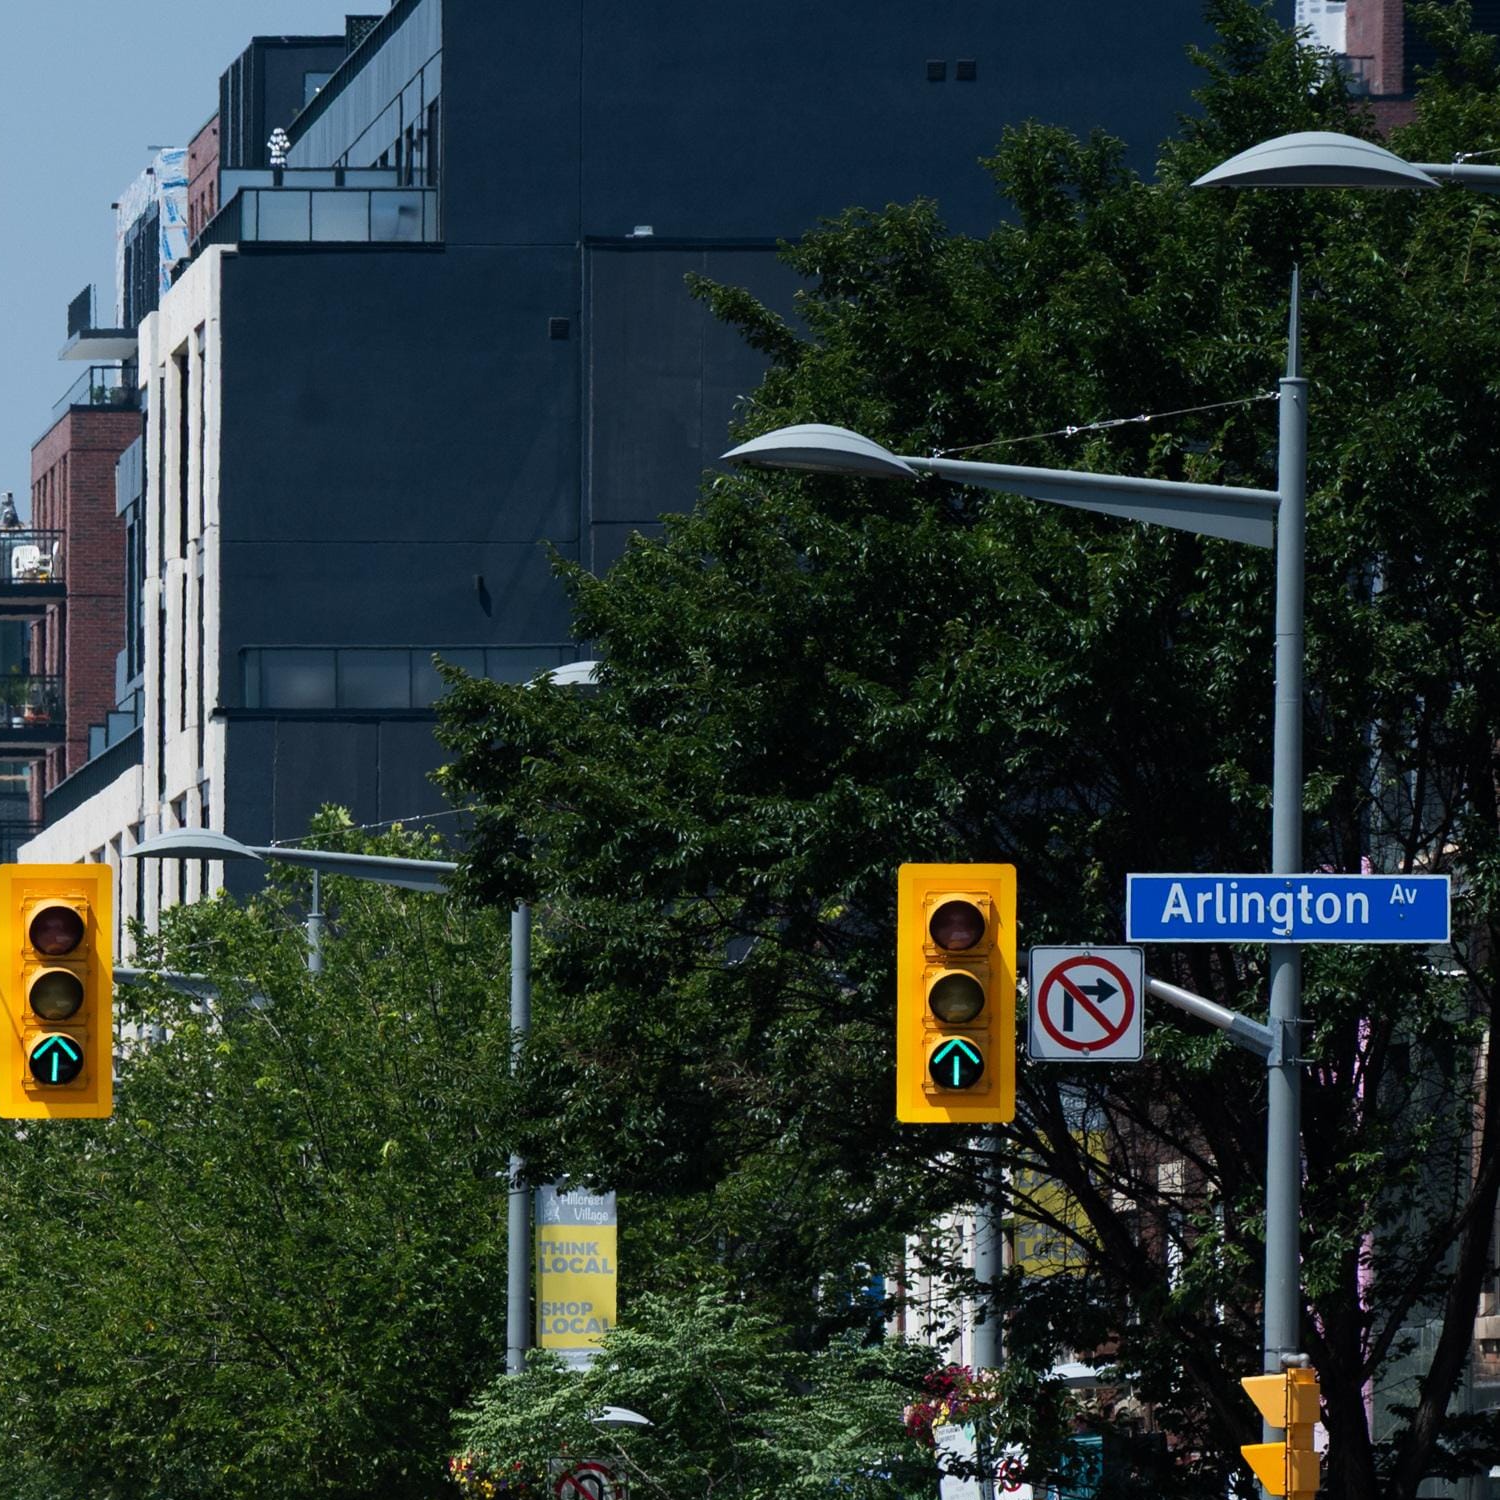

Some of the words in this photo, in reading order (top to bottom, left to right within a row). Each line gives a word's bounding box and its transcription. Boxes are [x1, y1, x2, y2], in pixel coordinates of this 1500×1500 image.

[1161, 882, 1370, 937] Arlington
[1389, 885, 1417, 905] Av
[574, 1207, 609, 1224] Village
[539, 1241, 600, 1256] THINK
[538, 1257, 614, 1274] LOCAL
[541, 1302, 593, 1316] SHOP
